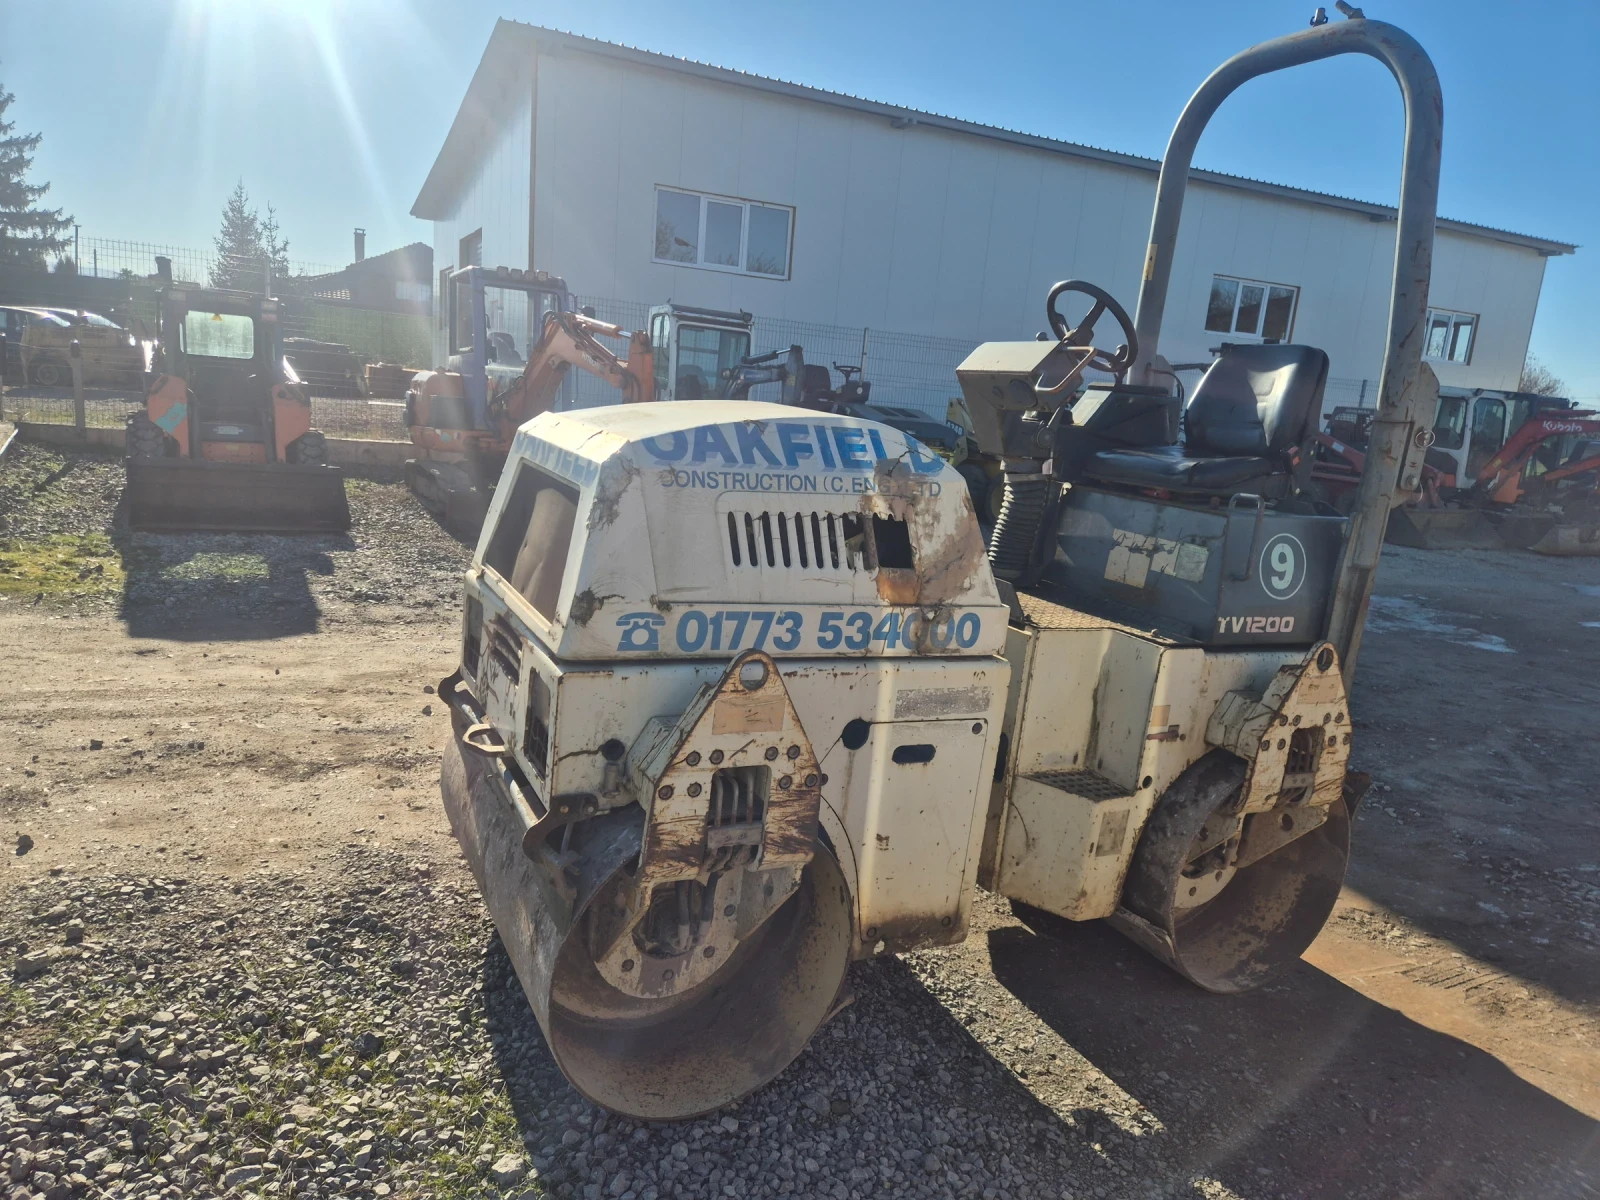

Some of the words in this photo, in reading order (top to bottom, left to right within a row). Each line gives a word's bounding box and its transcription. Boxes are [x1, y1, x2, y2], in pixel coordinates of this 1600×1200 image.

[1543, 420, 1583, 432] Kubota
[1271, 543, 1295, 590] 9
[675, 610, 804, 652] 01773
[816, 611, 981, 650] 534000
[1217, 616, 1295, 634] TV1200
